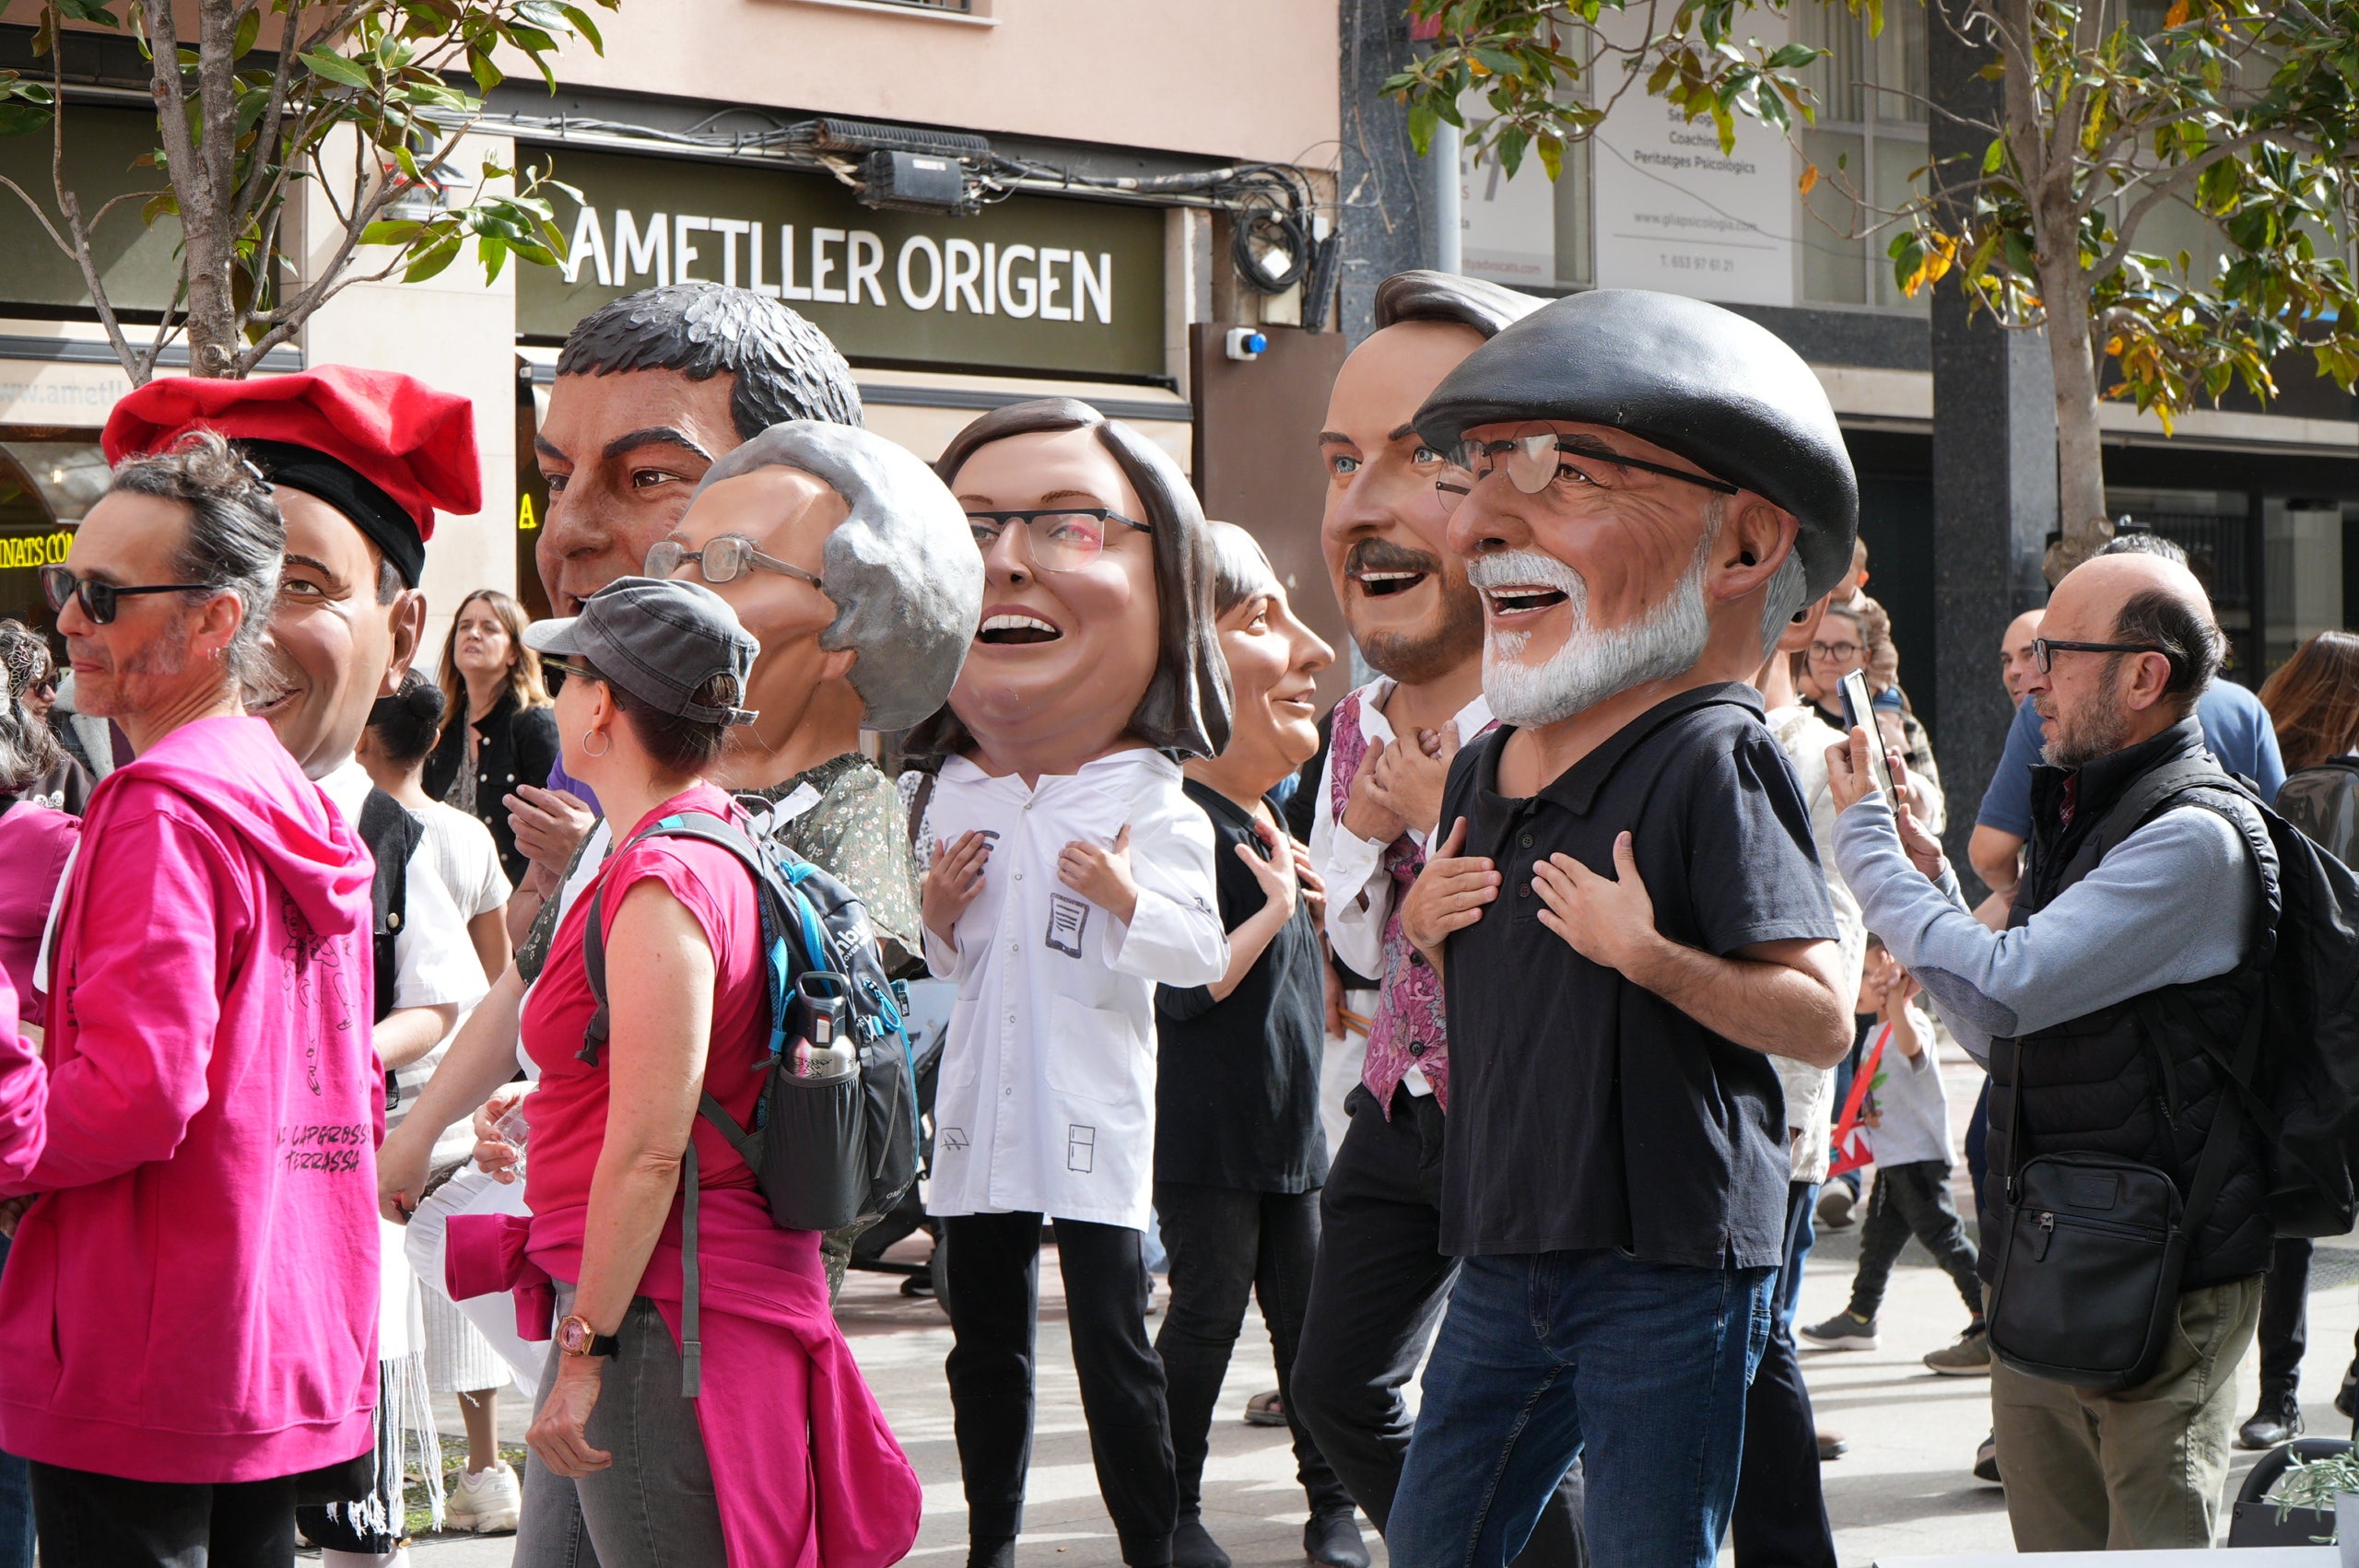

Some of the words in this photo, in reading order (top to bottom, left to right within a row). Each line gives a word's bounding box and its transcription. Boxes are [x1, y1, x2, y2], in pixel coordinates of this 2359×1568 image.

[1669, 131, 1721, 150] Coaching
[1634, 149, 1691, 170] Peritatges
[563, 205, 886, 307] AMETLLER
[898, 235, 1112, 324] ORIGEN
[519, 493, 536, 529] A
[286, 1149, 359, 1176] TERRASSA
